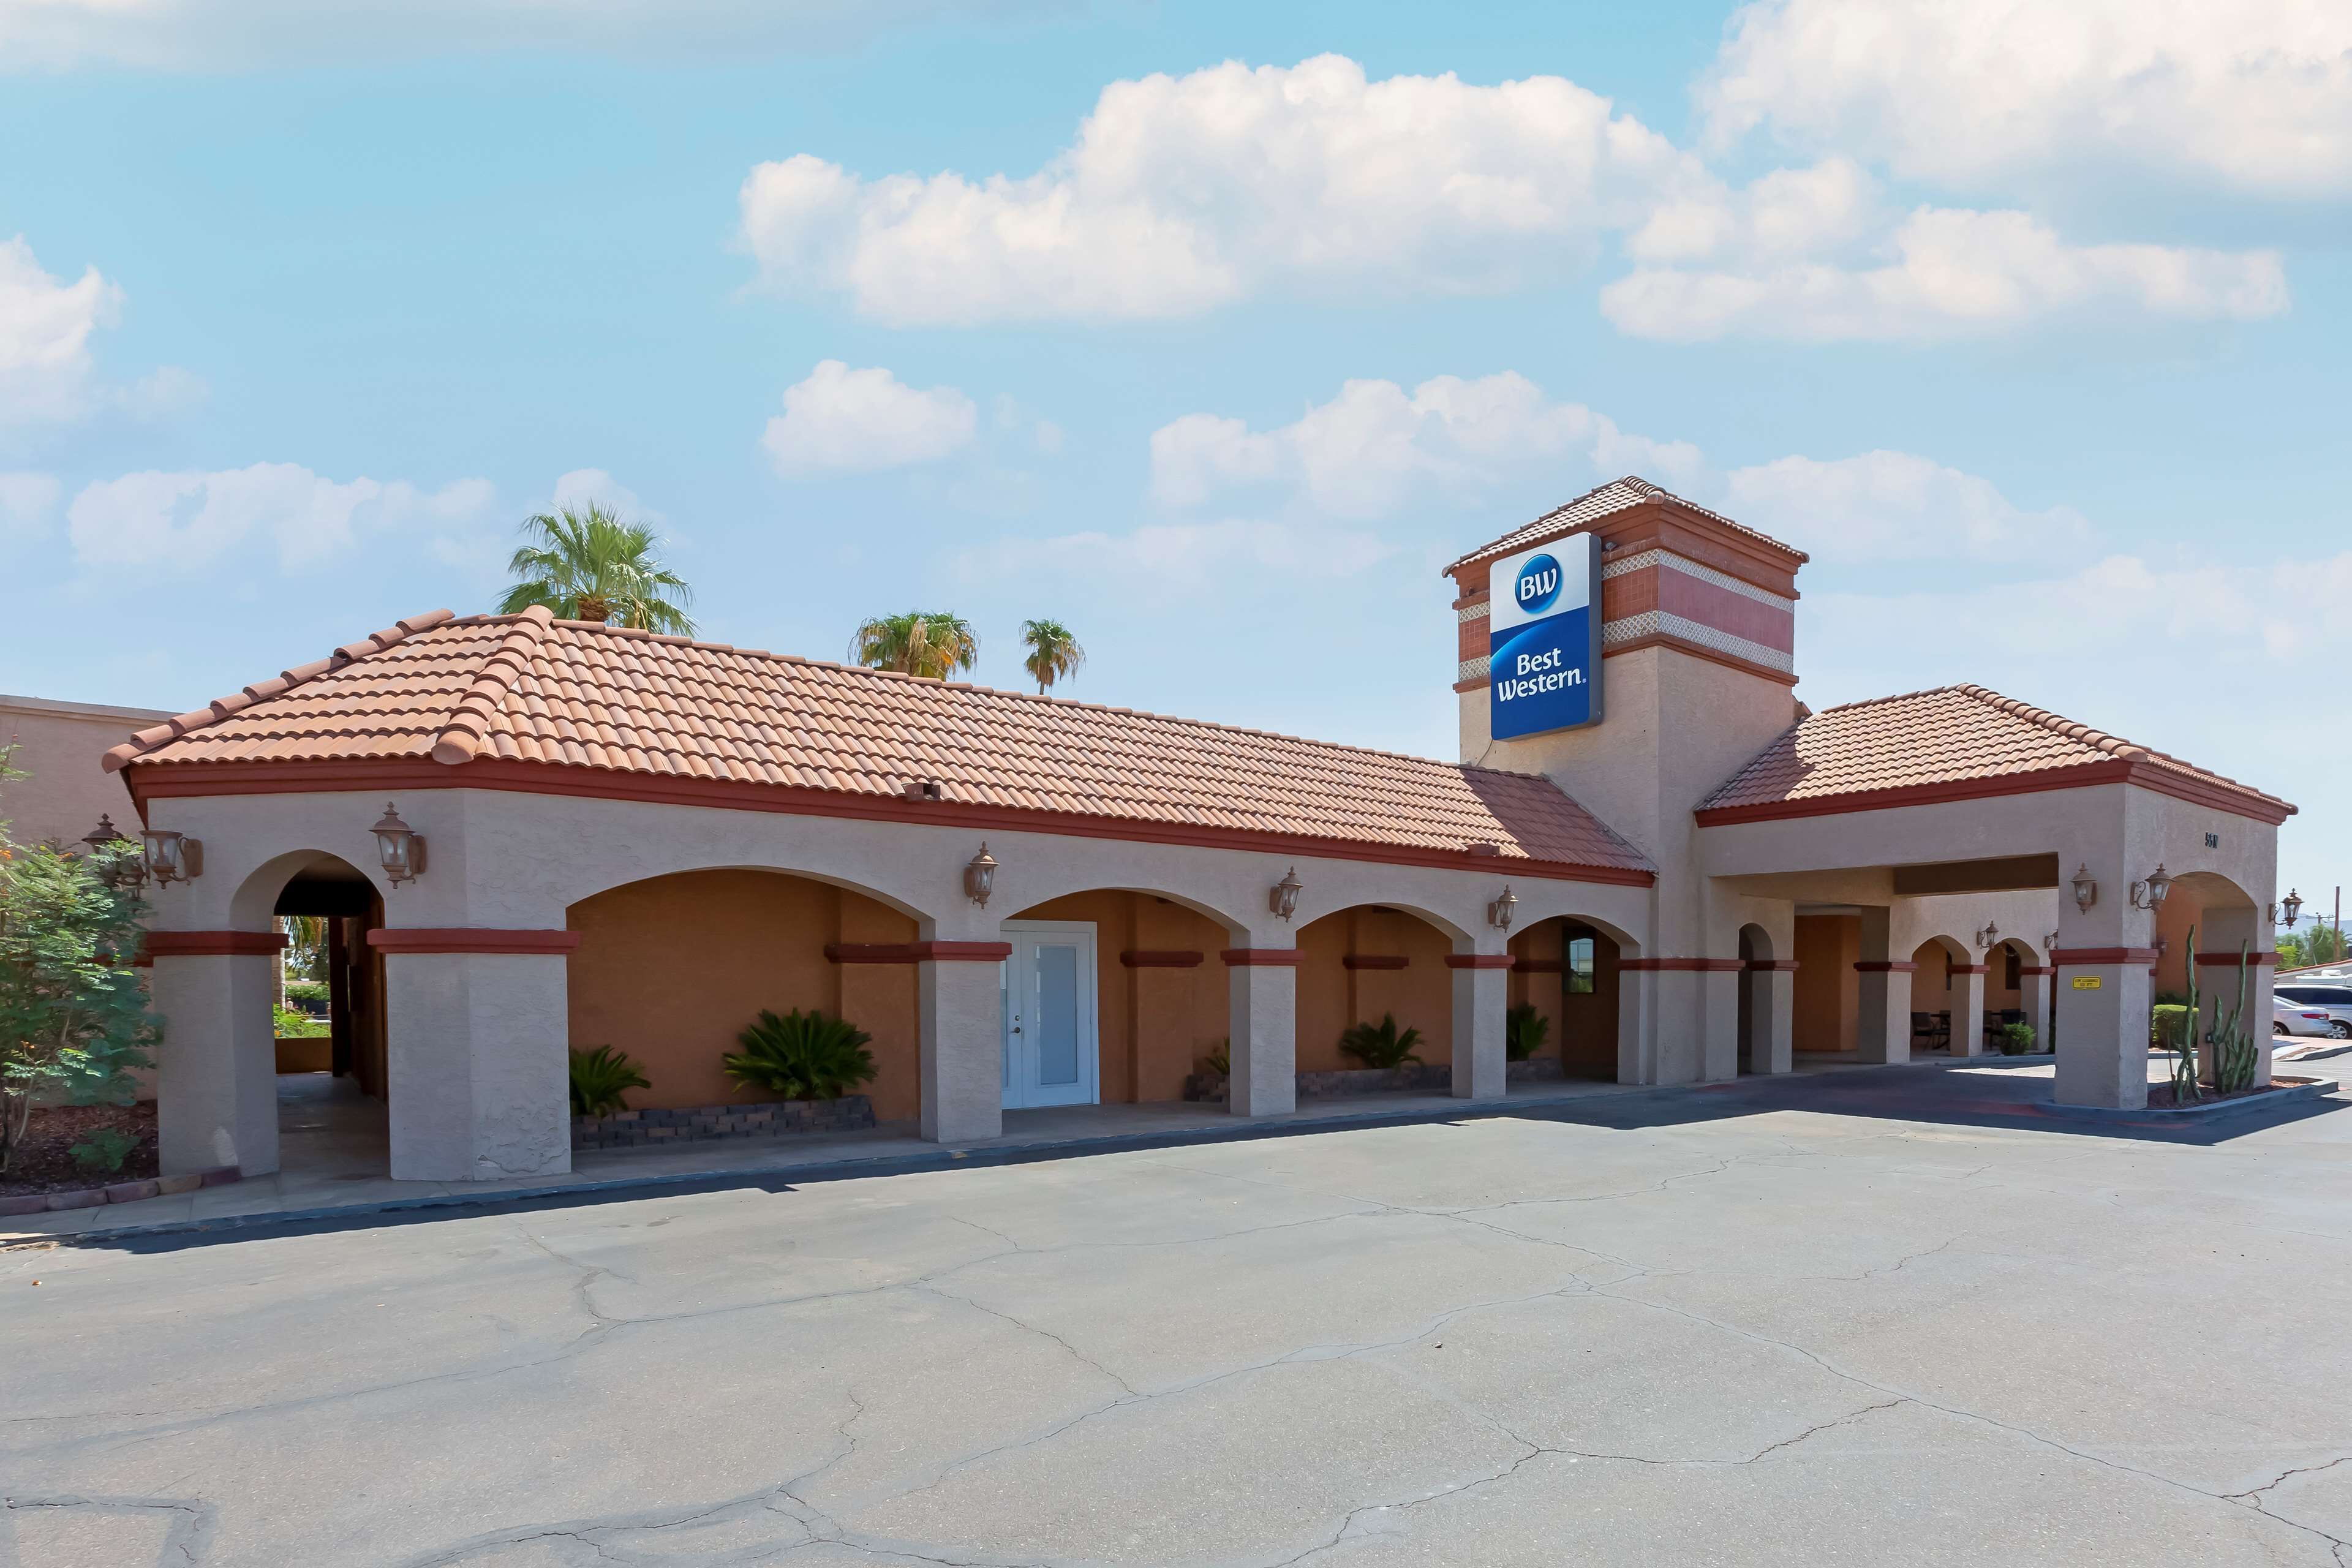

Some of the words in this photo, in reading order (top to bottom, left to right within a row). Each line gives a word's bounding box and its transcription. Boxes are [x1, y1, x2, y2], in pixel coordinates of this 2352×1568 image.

[1520, 568, 1557, 601] BW
[1517, 647, 1562, 676] Best
[1498, 668, 1582, 702] Western
